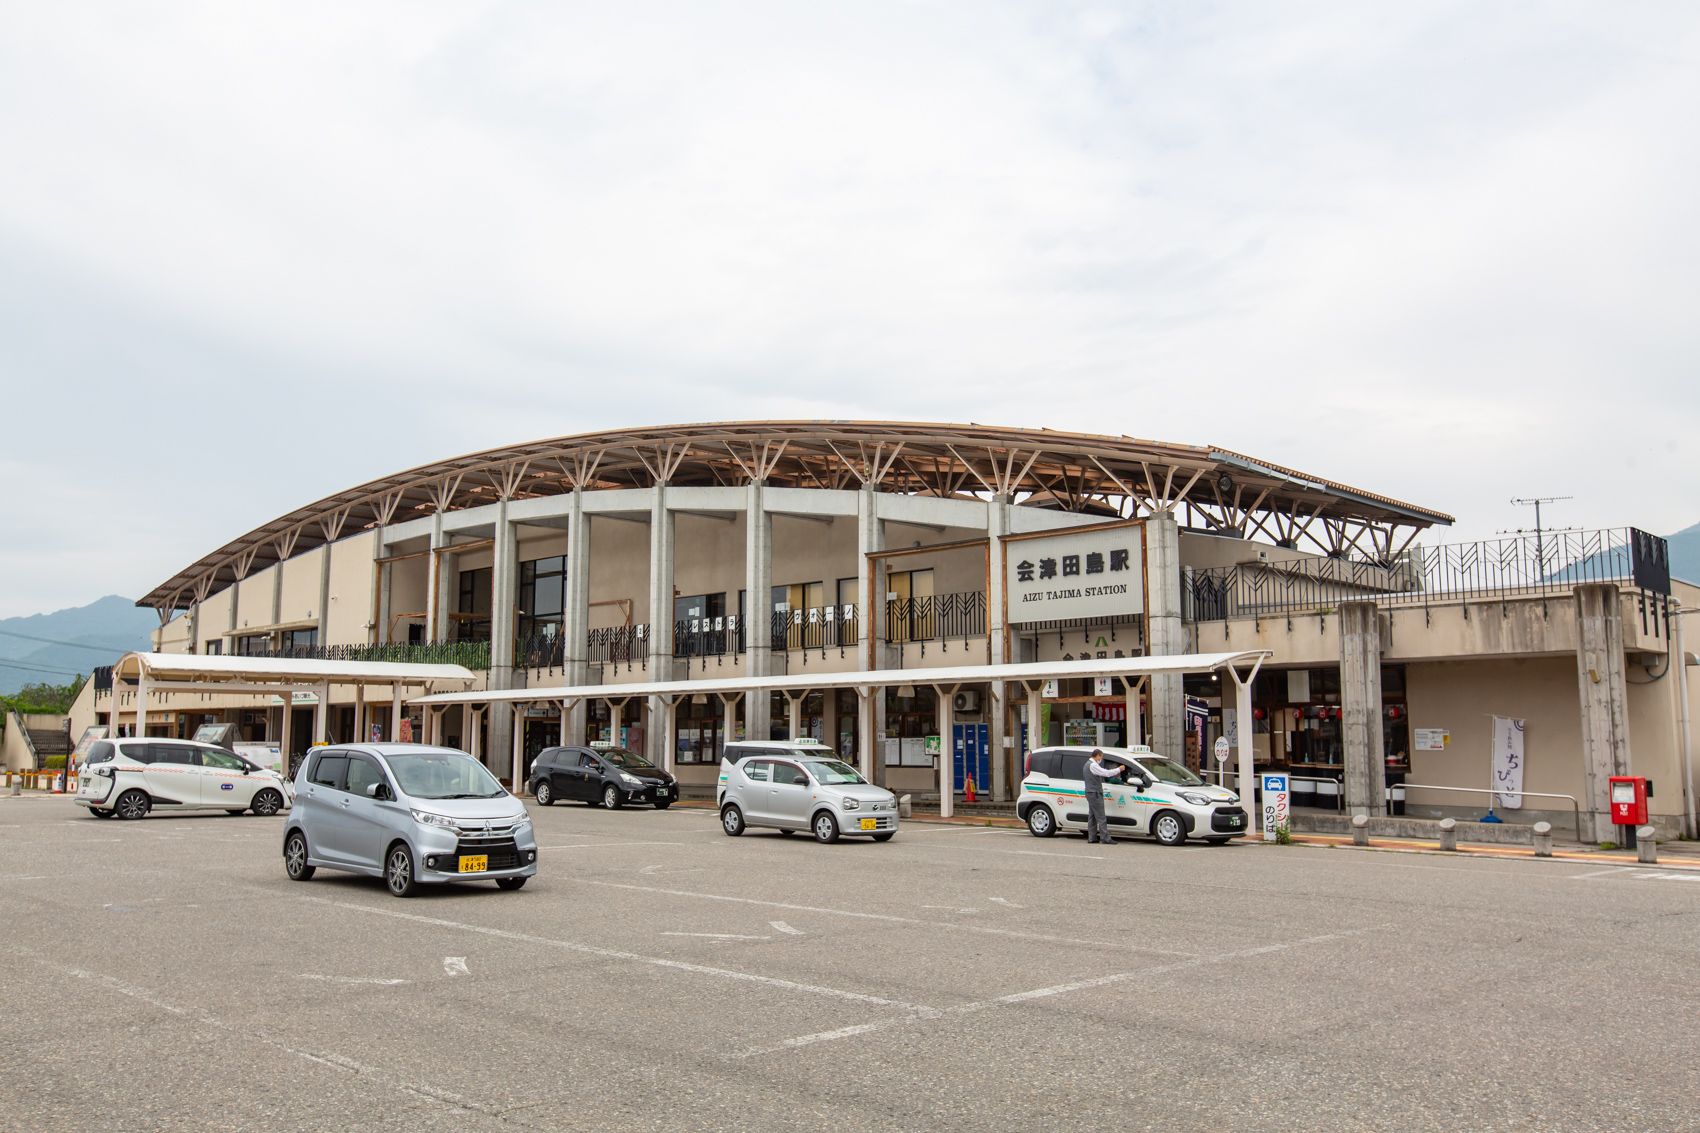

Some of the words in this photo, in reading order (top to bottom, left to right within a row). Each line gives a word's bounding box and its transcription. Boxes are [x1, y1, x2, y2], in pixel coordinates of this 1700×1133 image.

[1016, 548, 1130, 582] 会津田島駅
[1022, 592, 1044, 602] AIZU
[1046, 588, 1082, 600] TAJIMA
[1084, 584, 1128, 597] STATION
[1265, 805, 1276, 833] のりば
[1276, 793, 1287, 831] タクシー
[465, 861, 486, 871] 84-99
